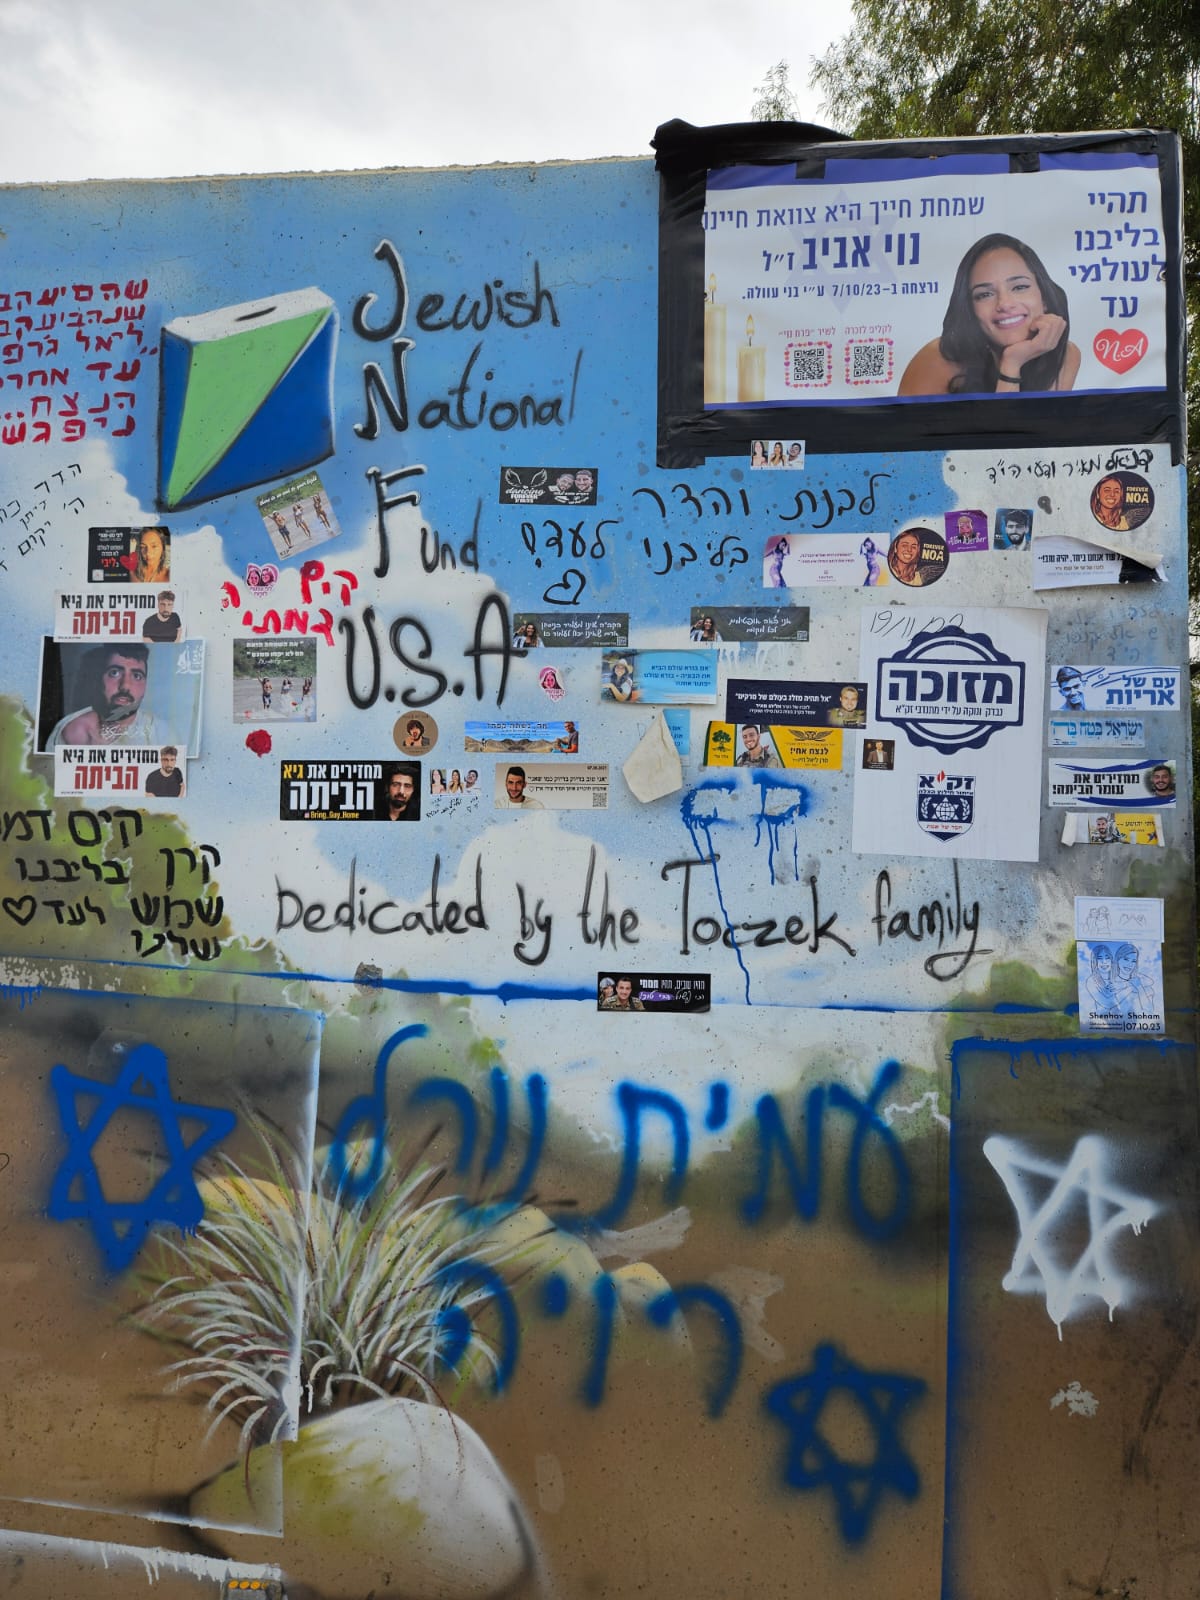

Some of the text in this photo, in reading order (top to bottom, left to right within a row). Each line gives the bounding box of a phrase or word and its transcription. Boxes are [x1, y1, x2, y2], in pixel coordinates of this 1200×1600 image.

[825, 202, 861, 223] היא
[870, 198, 912, 225] חייך
[920, 195, 985, 218] שמחת
[1087, 191, 1148, 214] תהיי
[757, 206, 817, 228] צוואת
[1074, 222, 1160, 252] בליבנו
[802, 235, 871, 270] אביב
[885, 233, 920, 266] נוי
[1068, 253, 1168, 284] לעולמי
[352, 238, 561, 342] Jewish
[783, 286, 800, 298] בני
[902, 281, 939, 295] נרצחה
[1101, 296, 1139, 319] עד
[86, 358, 141, 382] עד
[353, 336, 583, 440] National
[632, 483, 751, 519] והדר
[1125, 492, 1150, 504] NOA
[365, 463, 484, 578] Fund
[921, 548, 944, 562] NOA
[61, 594, 156, 610] מחזירים את גיא
[72, 611, 137, 635] הביתה
[337, 593, 529, 710] U.S.A
[888, 669, 1013, 705] מזוכה
[1121, 674, 1176, 689] עם של
[1105, 687, 1176, 706] אריות
[915, 705, 940, 715] מתנדבי
[941, 706, 951, 715] ידי
[951, 705, 962, 716] על
[984, 707, 1003, 717] נבדק
[63, 749, 159, 764] מחזירים את גיא
[74, 765, 140, 790] הביתה
[283, 763, 383, 780] מחזירים את גיא
[1073, 773, 1140, 785] מחזירים את
[289, 781, 375, 811] הביתה
[1052, 784, 1125, 796] עומר הביתה!
[0, 809, 144, 849] קים דמ
[14, 855, 131, 885] בליבנו
[158, 844, 222, 893] קרן
[42, 895, 107, 926] לעד
[129, 891, 225, 929] שמש
[274, 843, 994, 983] Dedicated by the Toczek family
[1088, 1011, 1160, 1020] Shenhav Shoham
[553, 1058, 914, 1241] עמית
